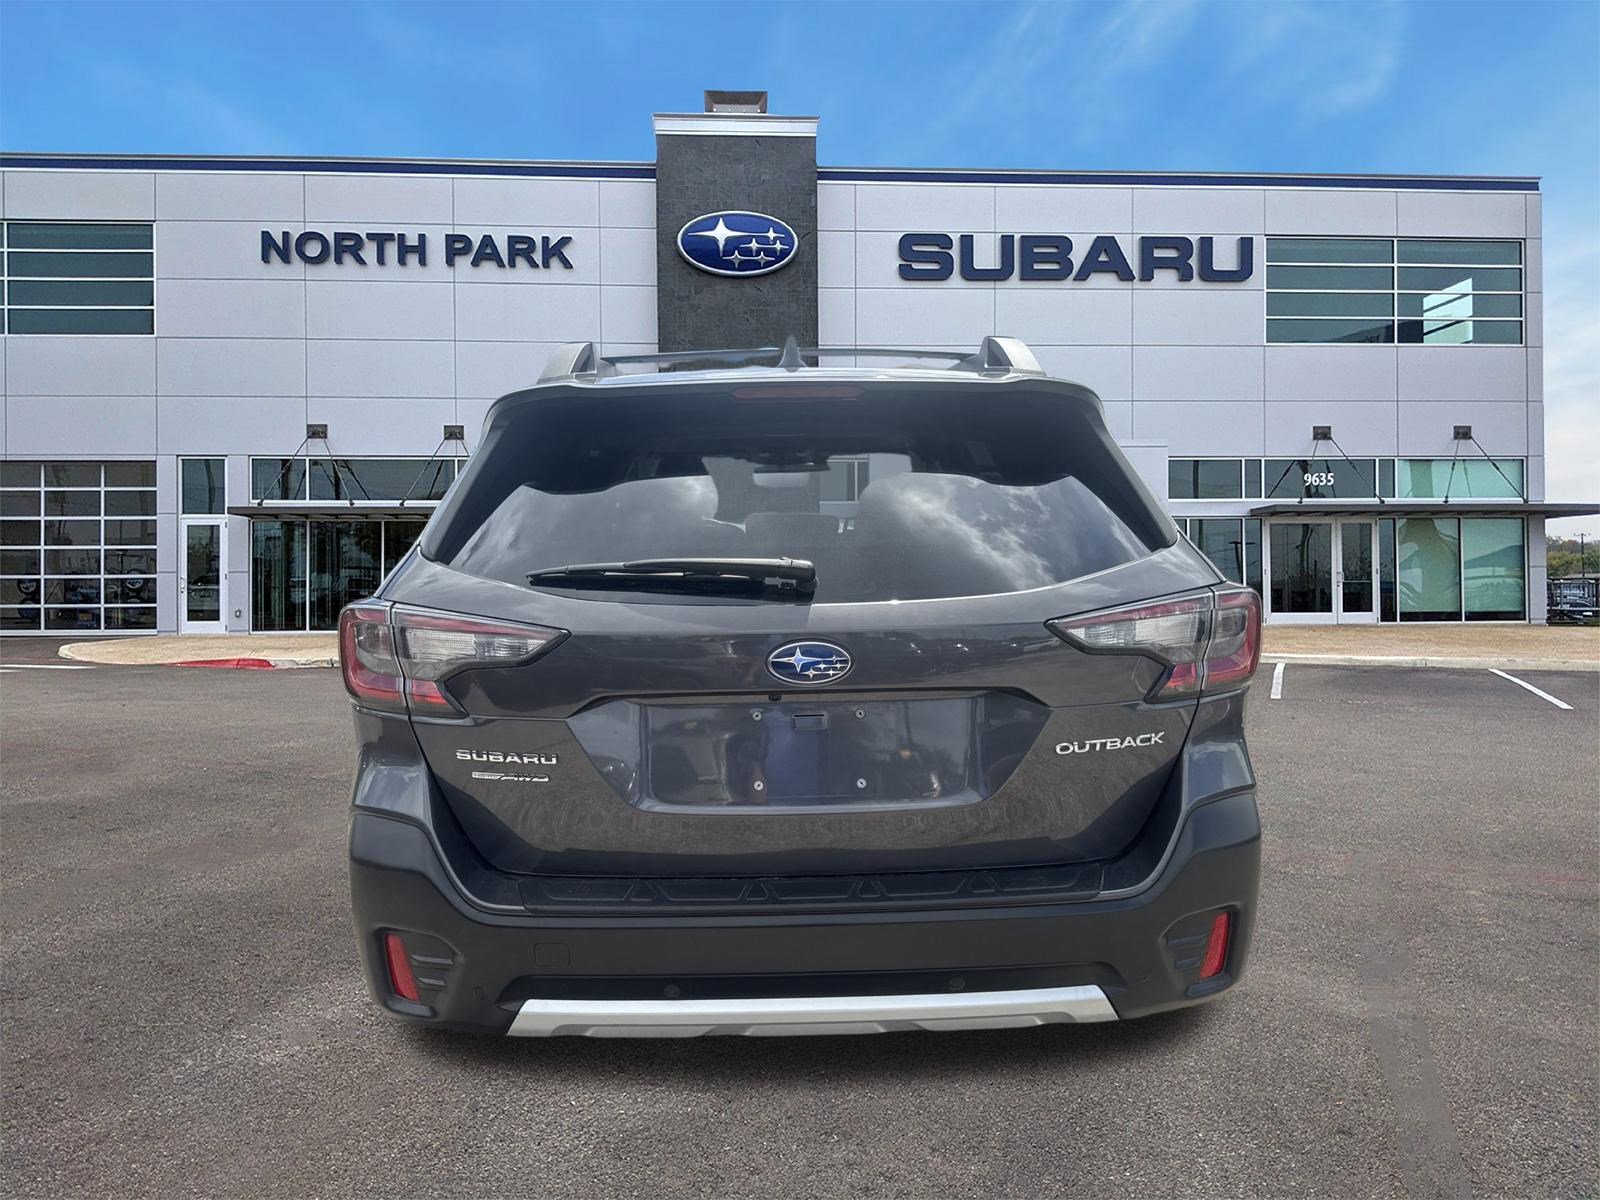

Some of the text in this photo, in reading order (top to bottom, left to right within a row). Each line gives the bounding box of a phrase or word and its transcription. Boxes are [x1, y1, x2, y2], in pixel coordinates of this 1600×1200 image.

[261, 230, 574, 270] NORTH PARK
[898, 233, 1254, 283] SUBARU
[1303, 472, 1335, 487] 9635
[1055, 731, 1166, 755] OUTBACK
[455, 748, 558, 765] SUBARU
[500, 773, 550, 783] AWD
